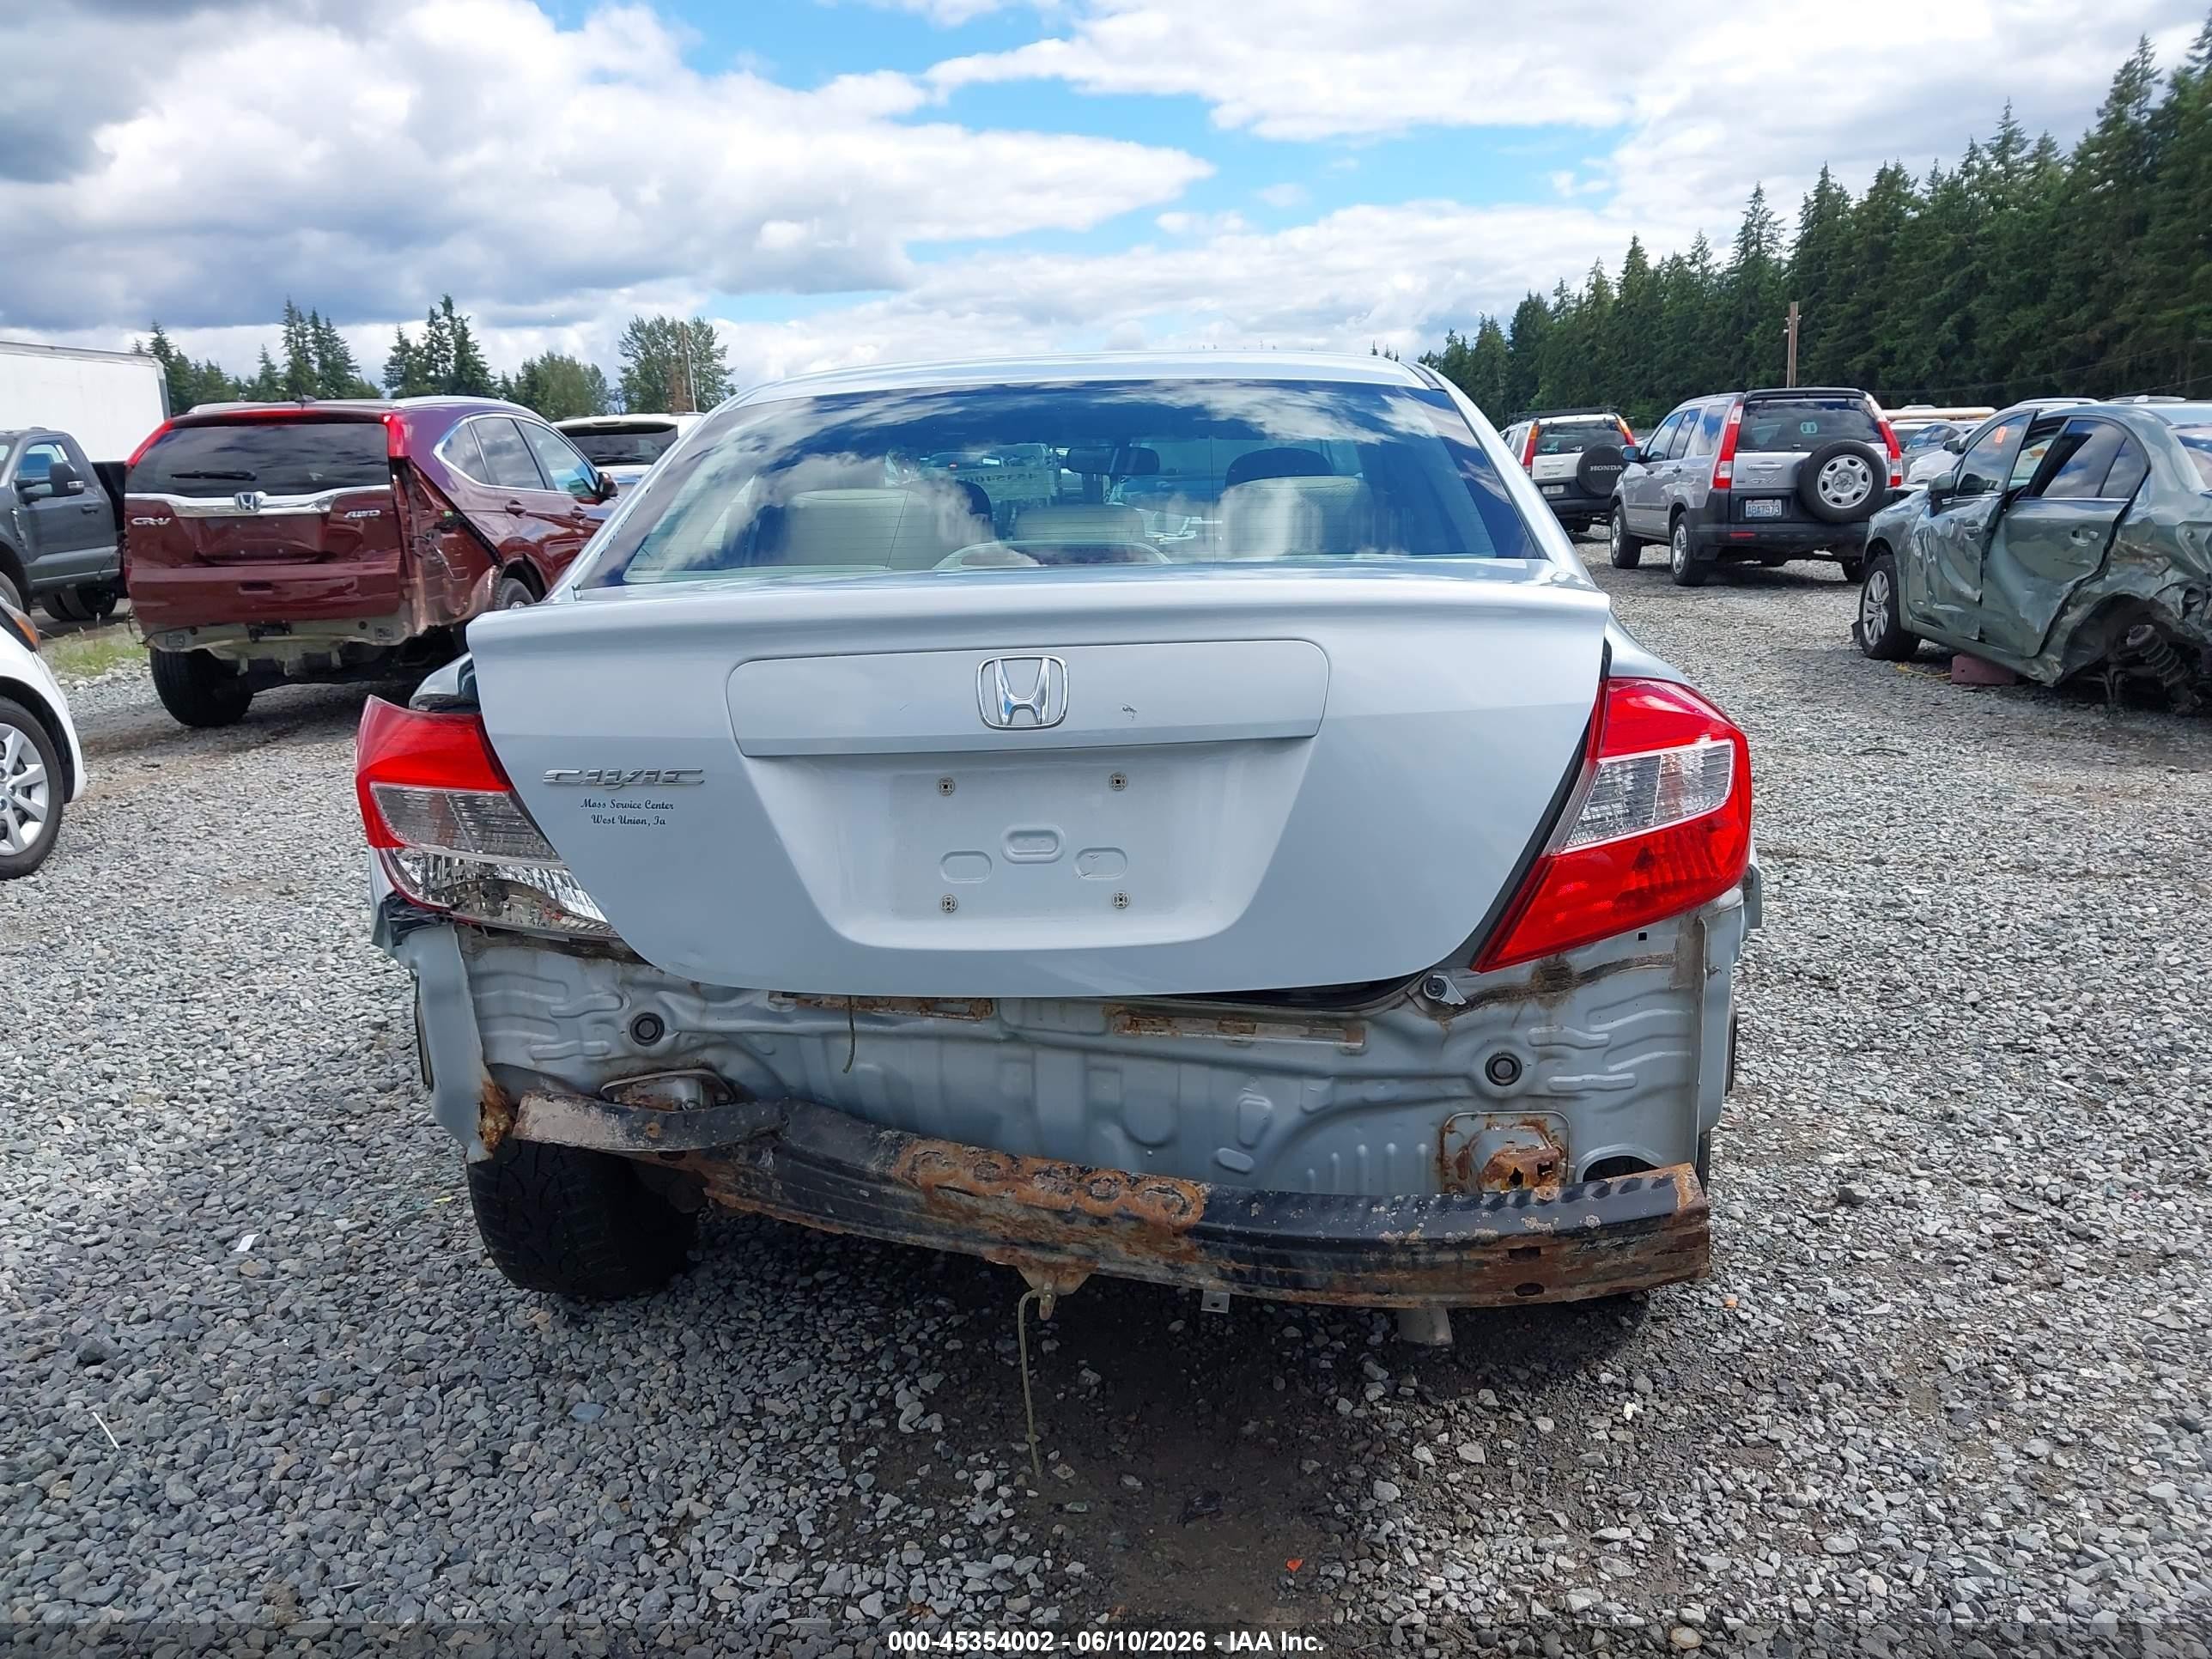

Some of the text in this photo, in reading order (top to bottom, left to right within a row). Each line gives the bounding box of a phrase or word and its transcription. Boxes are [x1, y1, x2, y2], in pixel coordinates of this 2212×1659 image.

[543, 769, 705, 790] CIVIC
[610, 799, 642, 810] Service
[644, 799, 674, 811] Center
[591, 815, 615, 824] West
[618, 815, 651, 827] Union,
